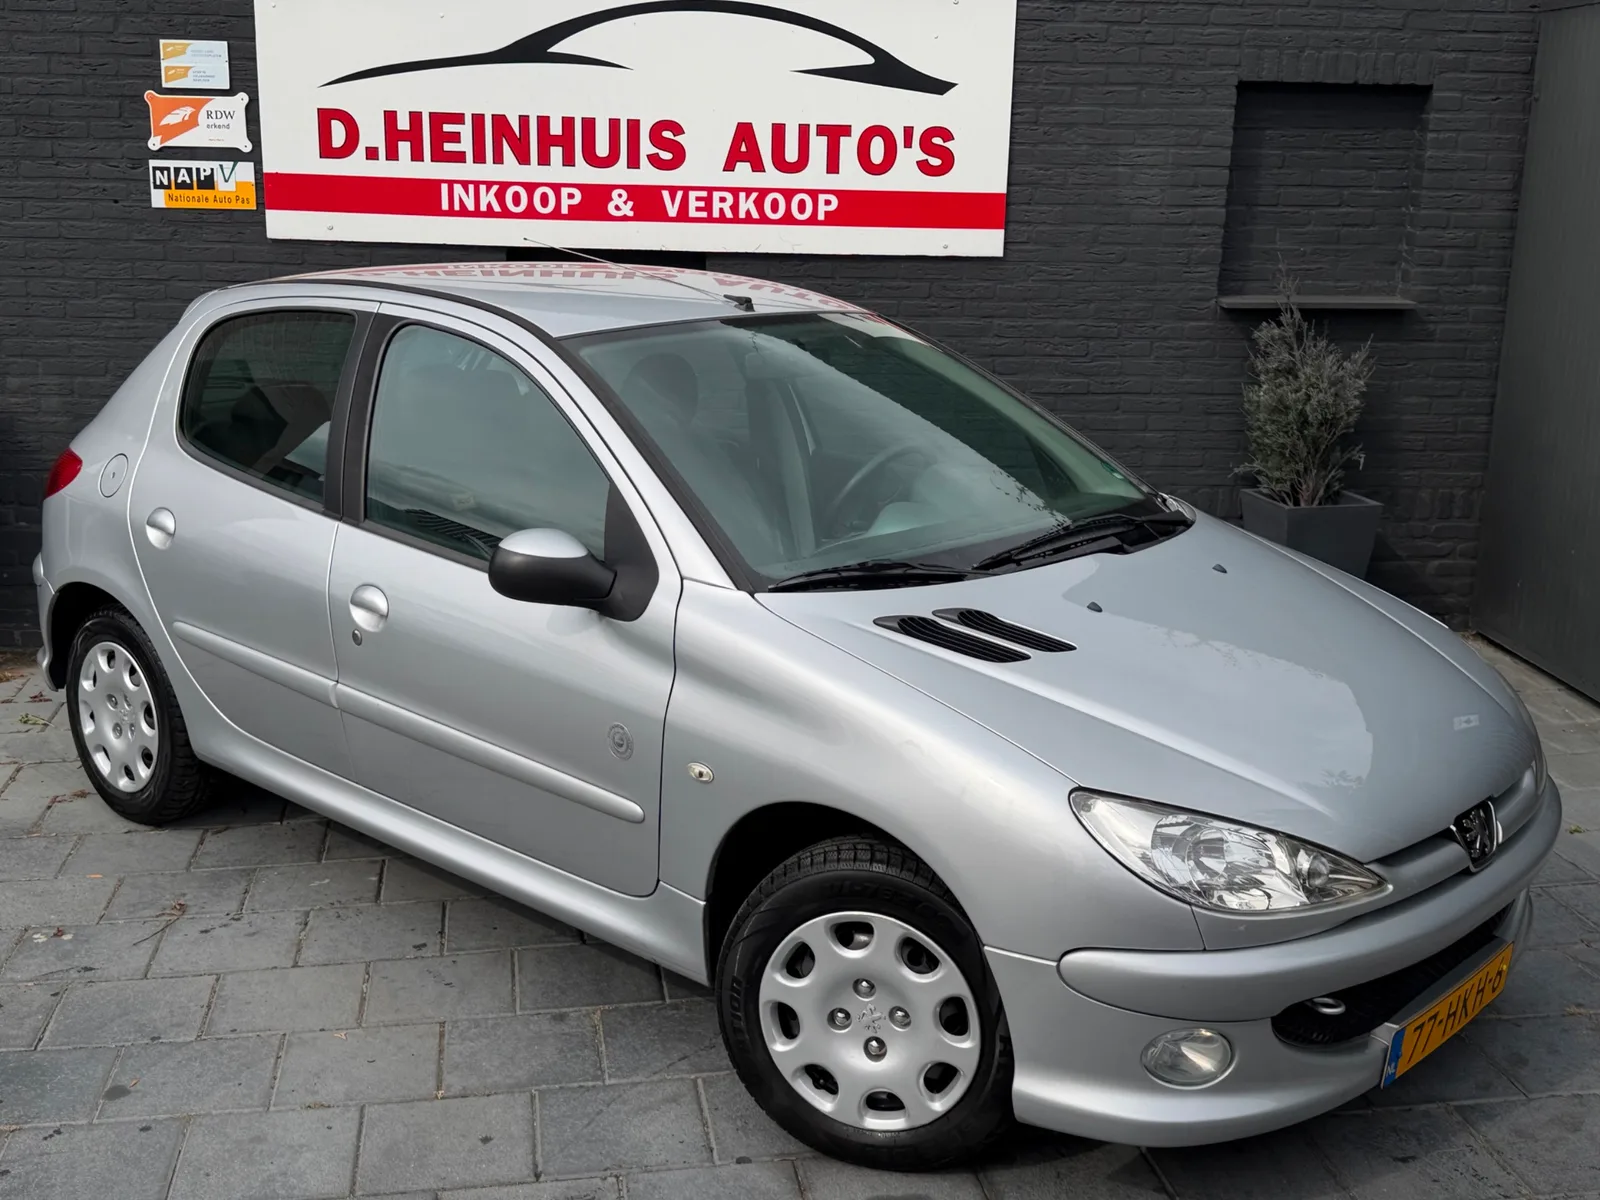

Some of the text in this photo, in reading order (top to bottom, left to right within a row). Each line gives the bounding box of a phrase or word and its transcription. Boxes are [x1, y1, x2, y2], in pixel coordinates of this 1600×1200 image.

[206, 110, 236, 120] RDW
[206, 122, 231, 130] erkend
[317, 107, 956, 177] D.HEINHUIS AUTO'S
[168, 193, 250, 205] Nationale Auto Pas
[439, 182, 840, 222] INKOOP & VERKOOP
[1407, 956, 1505, 1064] 77-HKH-6
